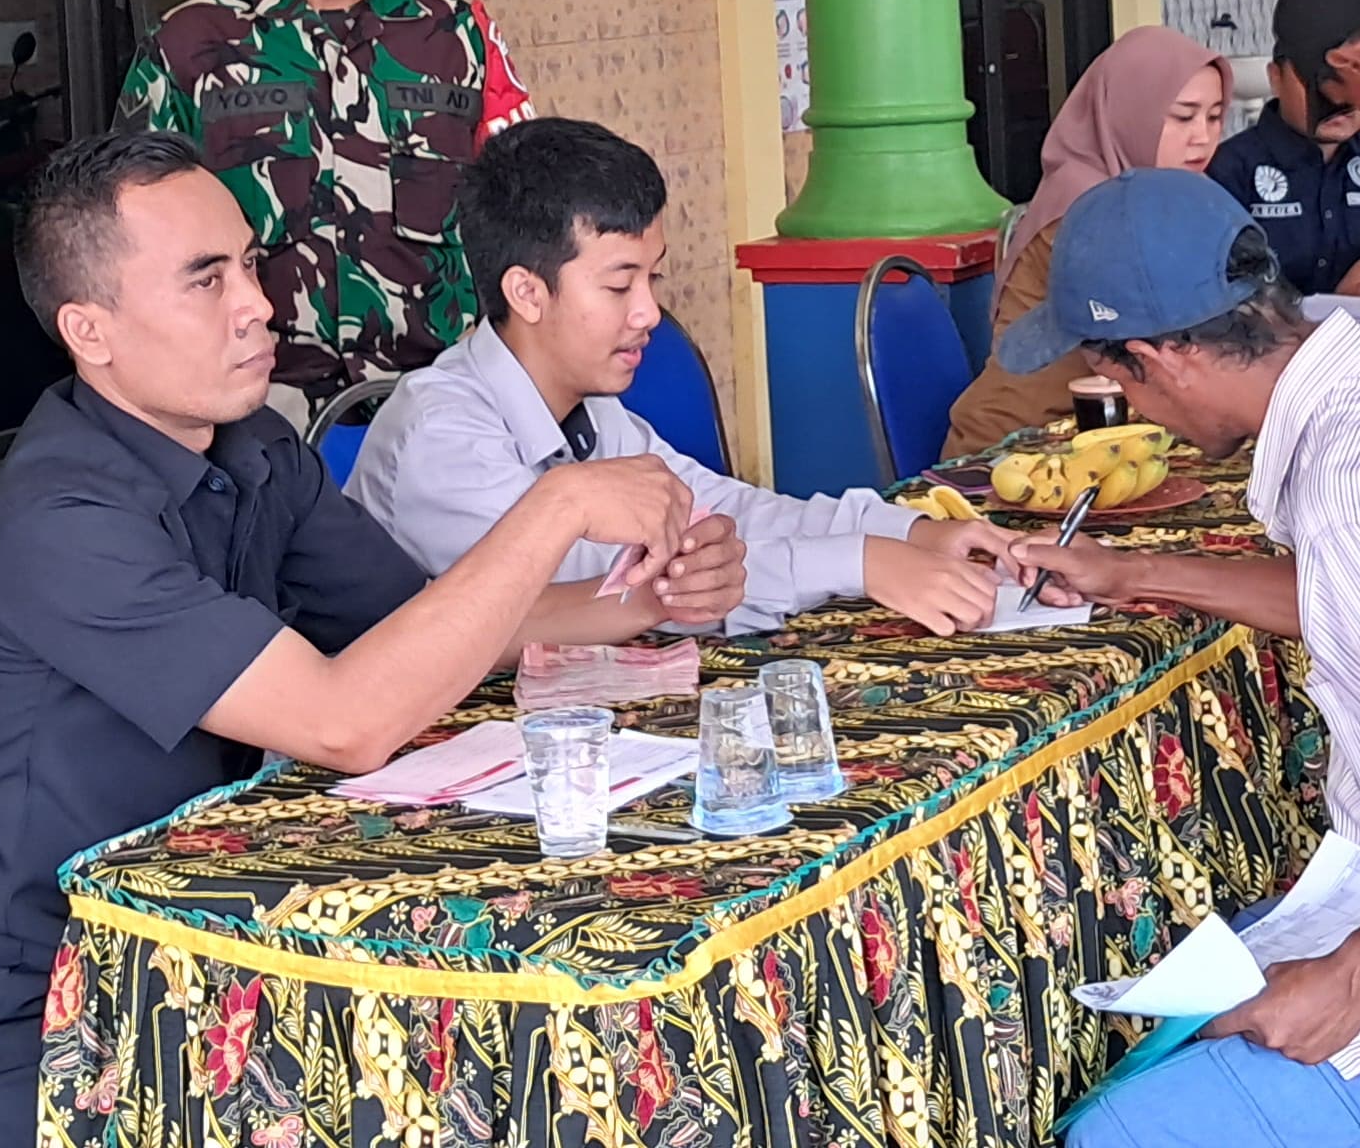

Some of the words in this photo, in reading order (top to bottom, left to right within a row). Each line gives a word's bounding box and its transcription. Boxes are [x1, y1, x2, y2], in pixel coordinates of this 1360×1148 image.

[219, 88, 288, 110] YOYO
[396, 86, 434, 103] TNI
[446, 91, 470, 110] AD
